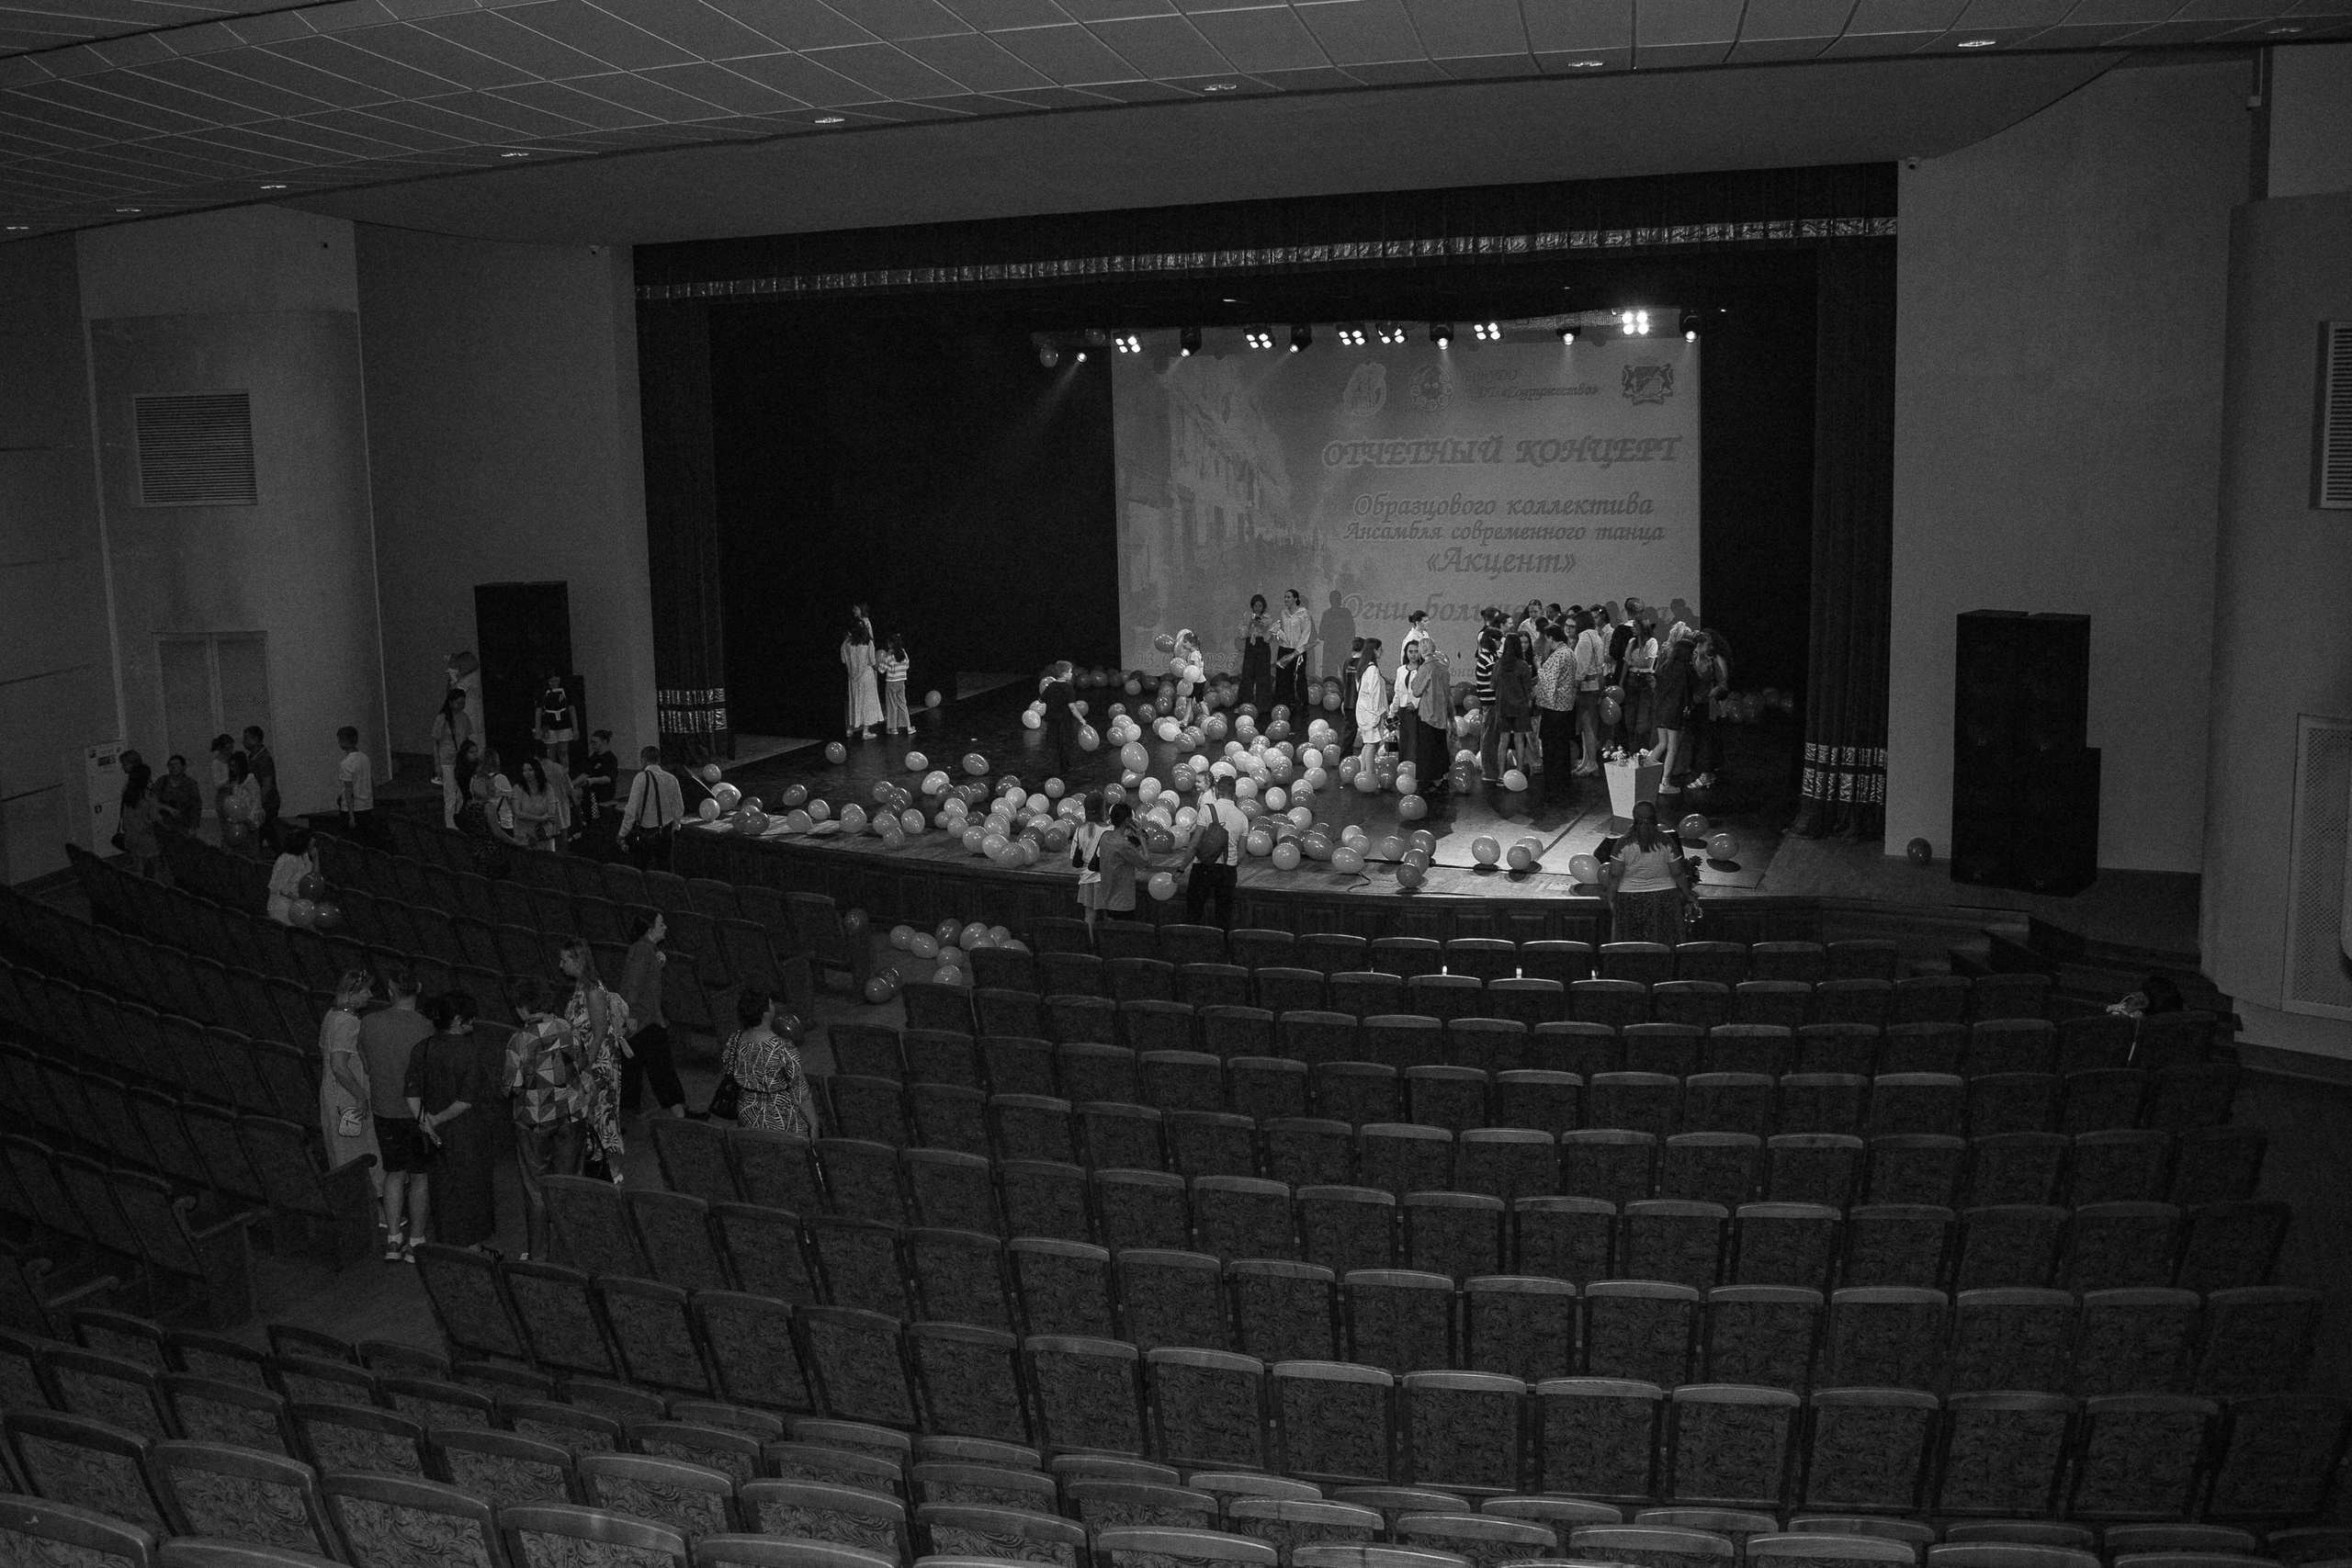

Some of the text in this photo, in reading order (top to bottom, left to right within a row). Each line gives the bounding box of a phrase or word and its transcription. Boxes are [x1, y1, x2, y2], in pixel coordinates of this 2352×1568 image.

[1323, 434, 1682, 468] ОТЧЕТНЫЙ КОНЦЕРТ
[1353, 491, 1654, 523] Образцового коллектива
[1343, 519, 1666, 546] Ансамбля современного танца
[1426, 547, 1577, 581] «Акцент»
[1340, 593, 1409, 621] Огни
